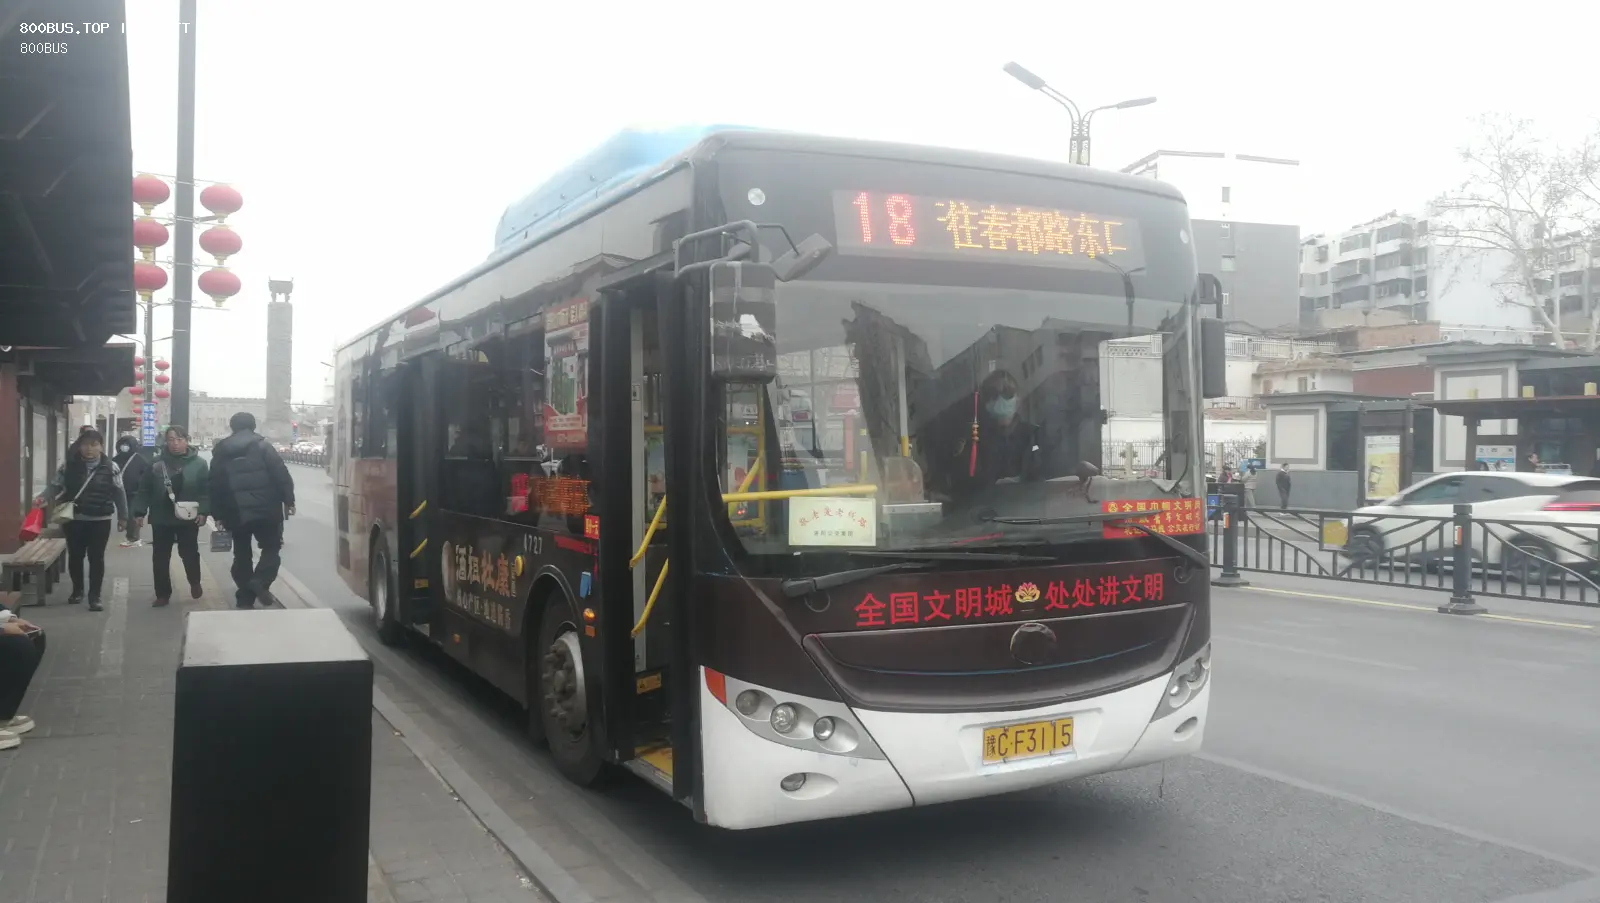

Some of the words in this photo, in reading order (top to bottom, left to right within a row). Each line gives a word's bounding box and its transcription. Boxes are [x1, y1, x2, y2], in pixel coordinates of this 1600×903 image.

[852, 191, 915, 245] 18
[854, 583, 1013, 627] 全国文明城
[1044, 572, 1165, 611] 处处讲文明
